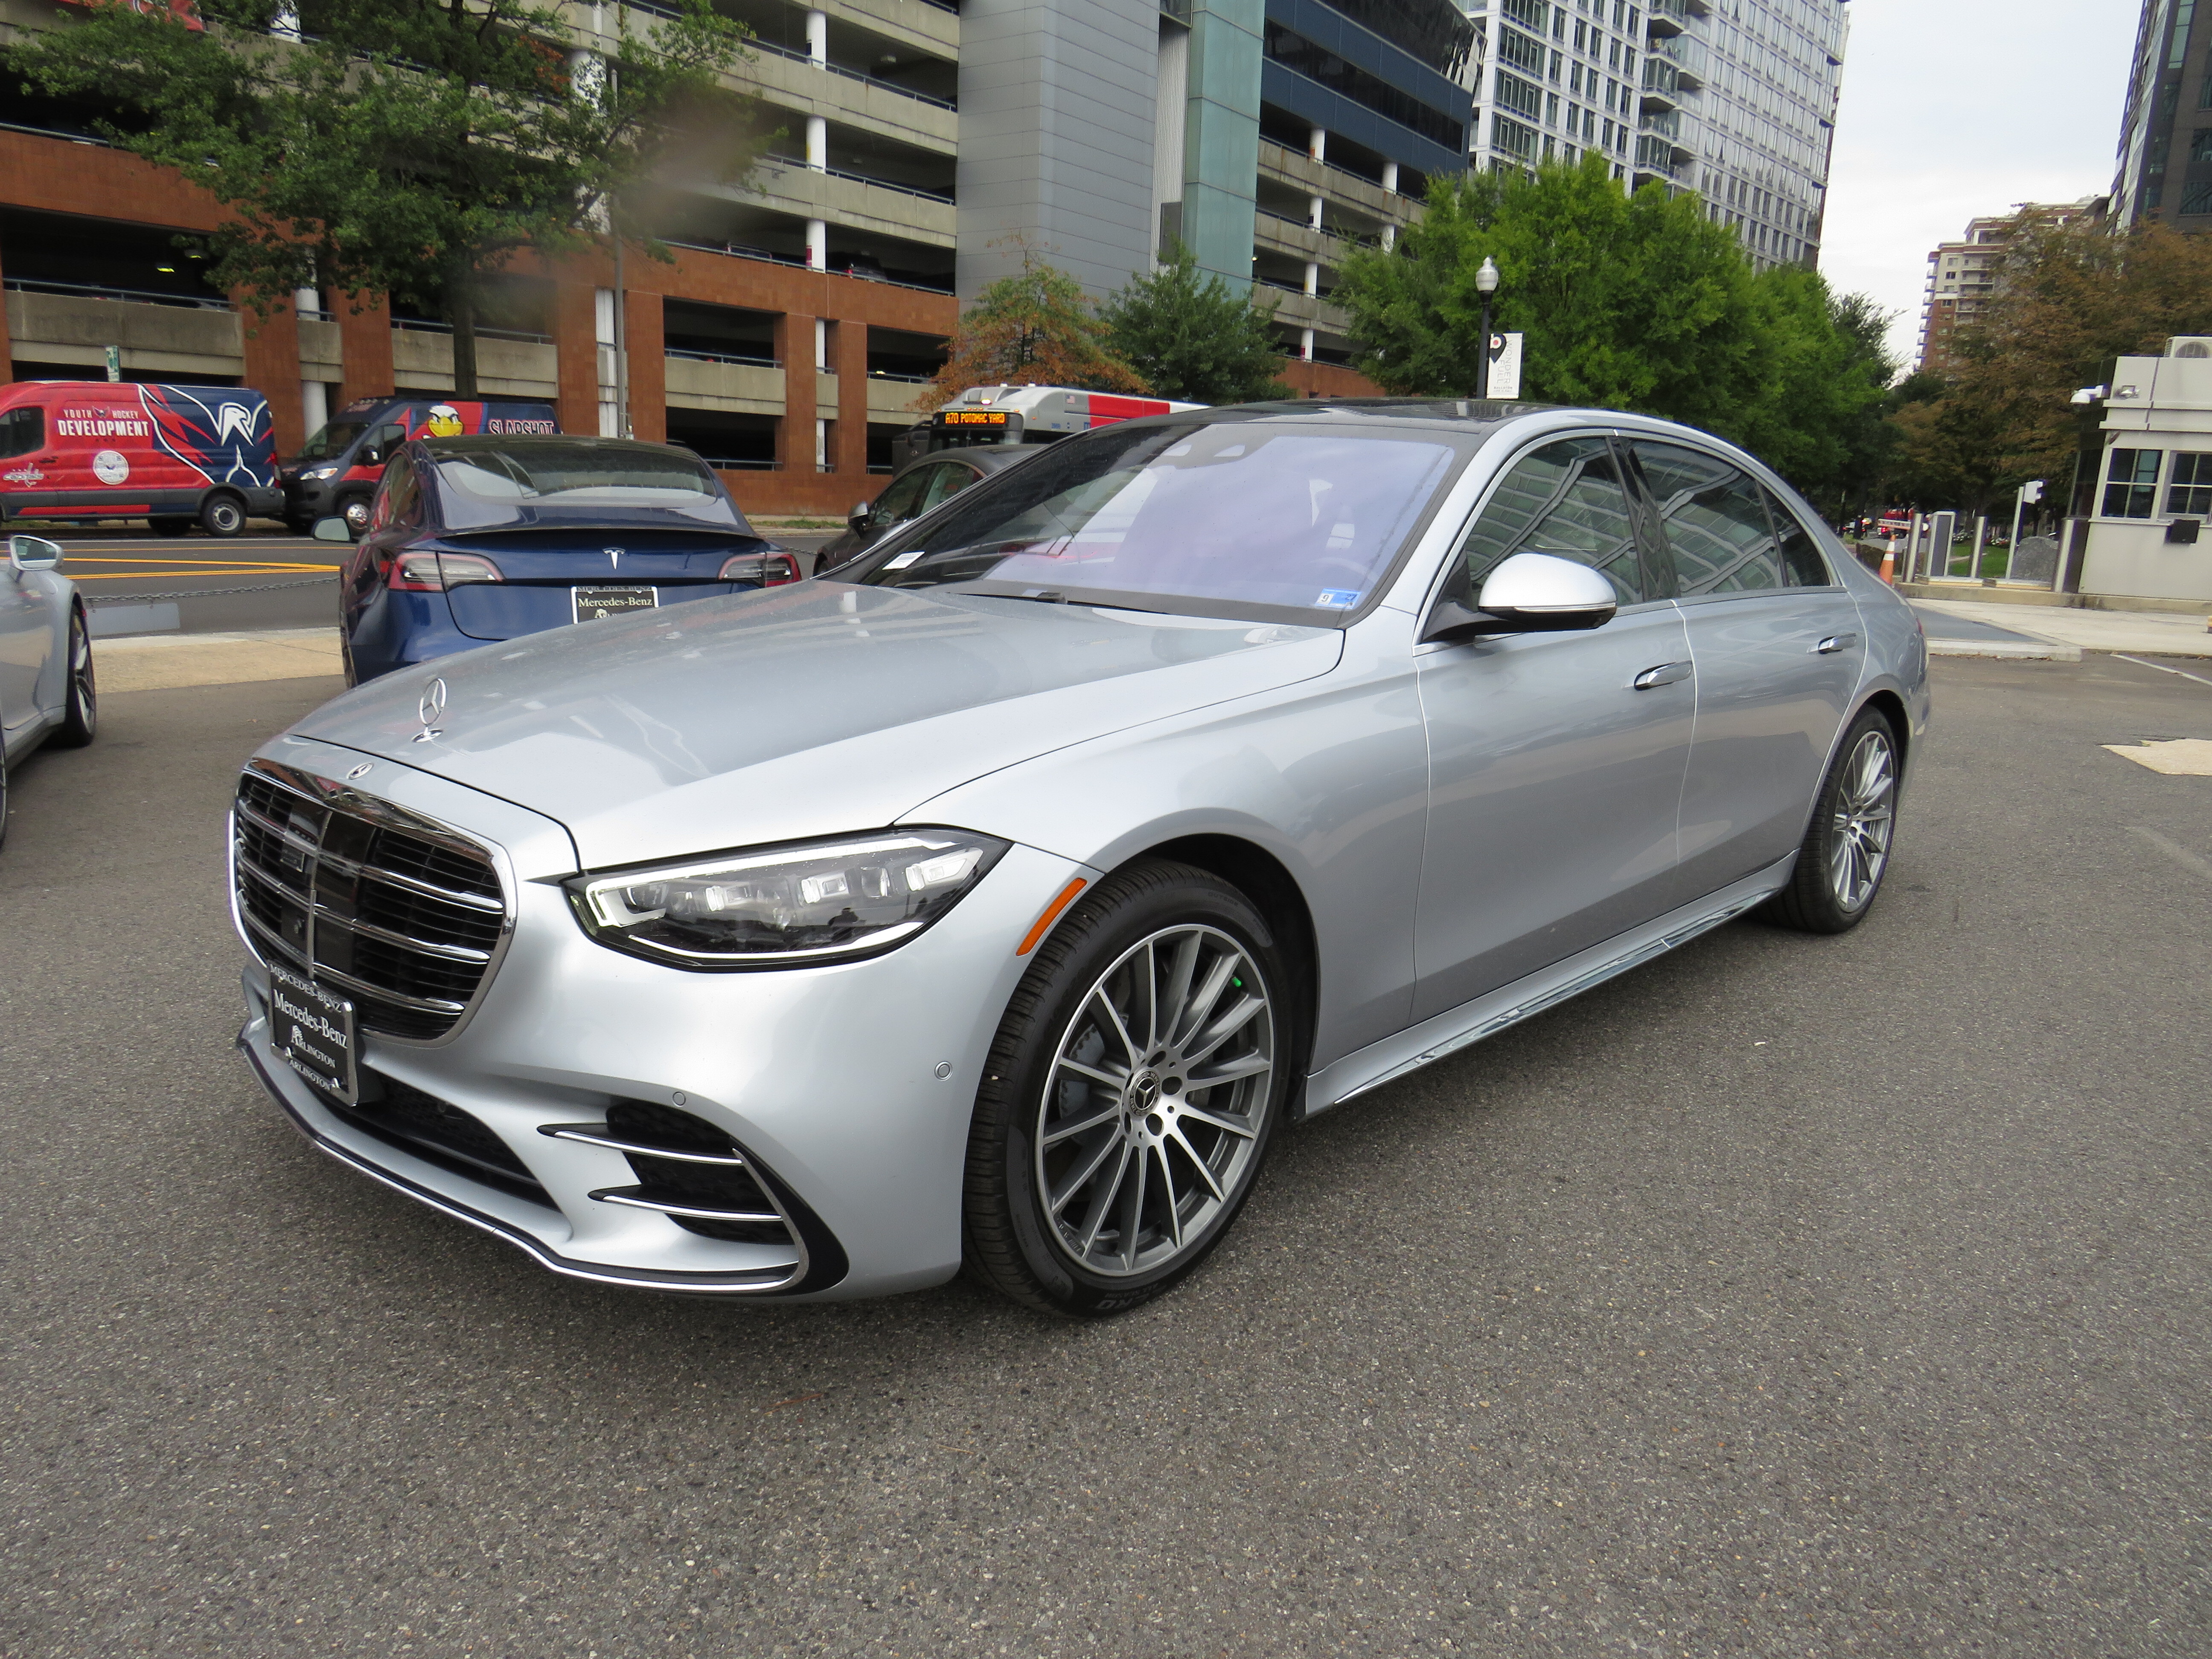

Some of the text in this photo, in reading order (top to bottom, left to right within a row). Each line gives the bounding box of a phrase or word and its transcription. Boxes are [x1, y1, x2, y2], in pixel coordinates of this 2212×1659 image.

[1497, 360, 1505, 383] FULL
[1504, 340, 1513, 384] WONDER
[57, 419, 149, 436] DEVELOPMENT
[64, 409, 139, 419] YOUTH HOCKEY
[945, 412, 1005, 424] A70 POTOMAC YARD
[577, 597, 653, 607] Mercedes-Benz
[270, 963, 343, 1013] MERCEDES-BENZ
[274, 989, 348, 1049] Mercedes-Benz
[291, 1033, 336, 1068] ARLINGTON
[289, 1059, 331, 1091] ARLINGTON
